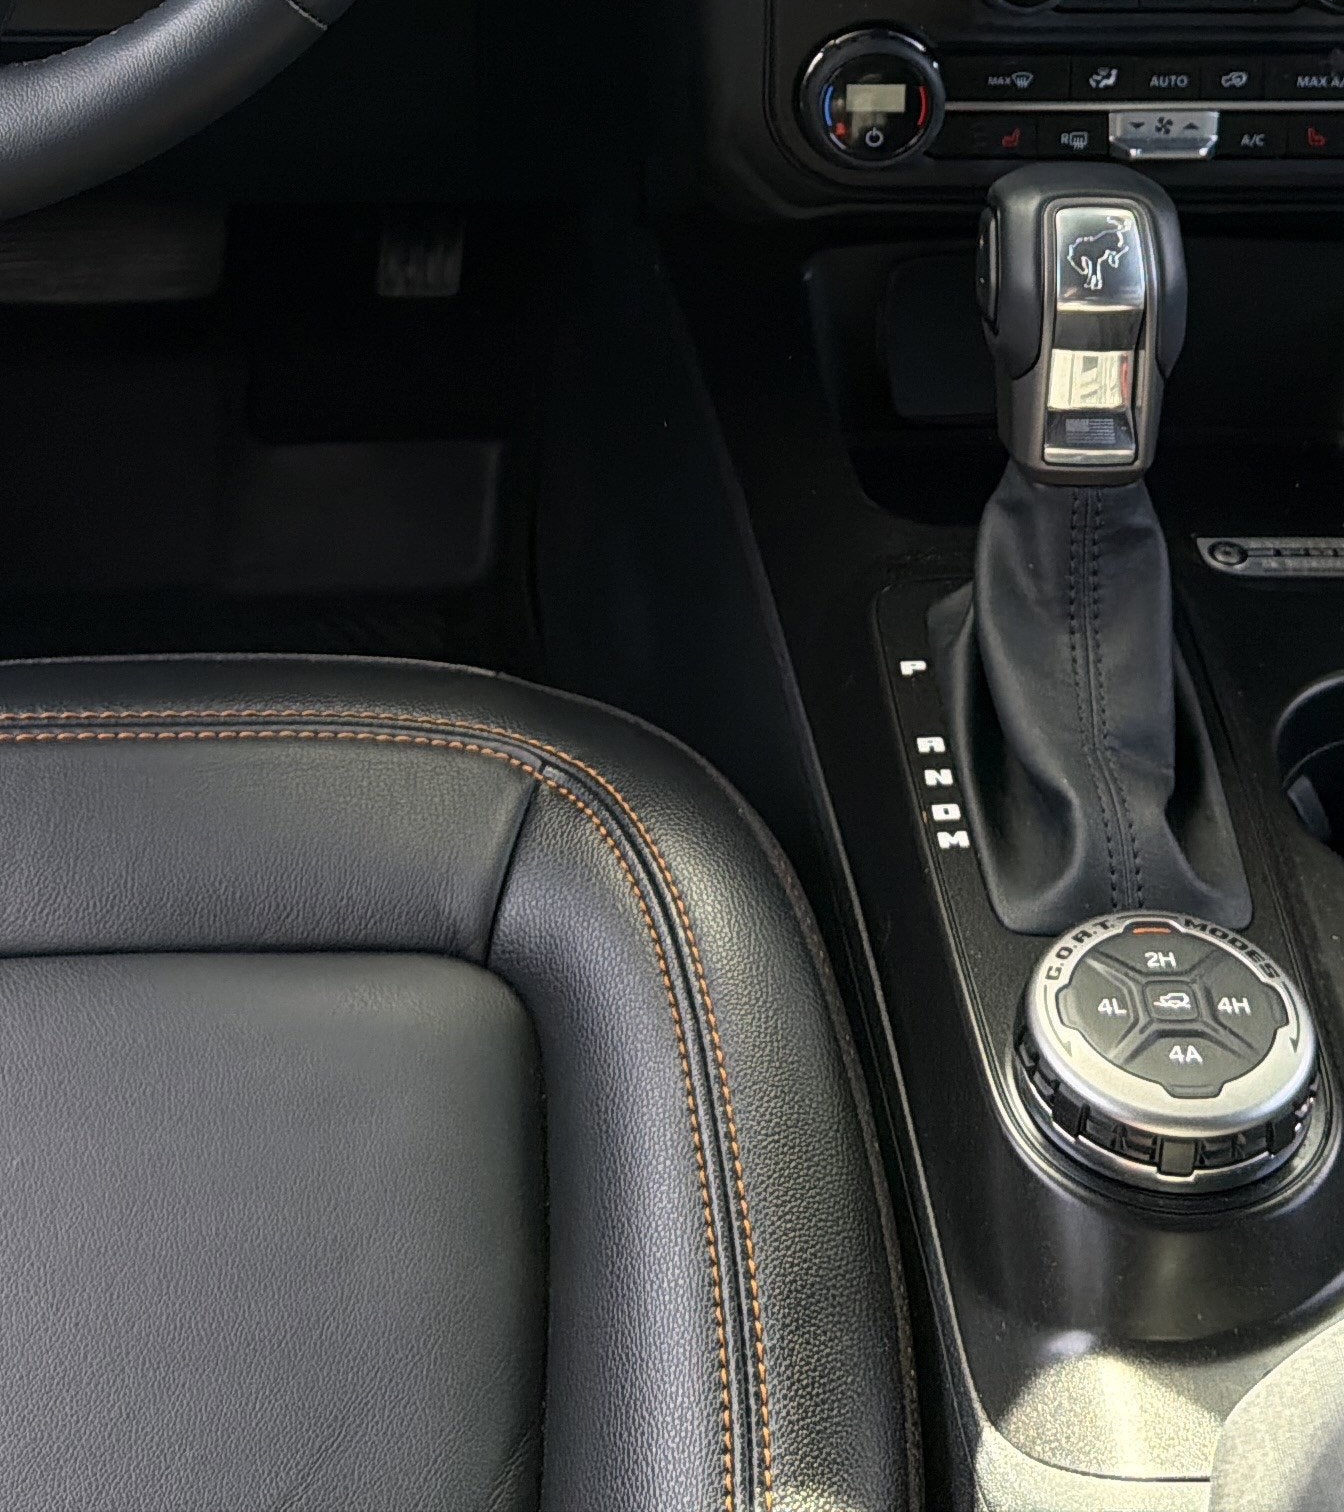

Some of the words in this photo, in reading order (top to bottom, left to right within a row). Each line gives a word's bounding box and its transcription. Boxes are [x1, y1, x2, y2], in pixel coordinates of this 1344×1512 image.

[987, 75, 1011, 86] MAX
[1150, 74, 1188, 88] AUTO
[1297, 74, 1327, 88] MAX
[1241, 133, 1265, 147] A/C
[899, 660, 927, 676] P
[924, 768, 954, 786] N
[936, 830, 970, 849] M
[1183, 918, 1279, 981] MODES
[1144, 951, 1177, 968] 2H
[1097, 997, 1127, 1015] 4L
[1217, 997, 1251, 1015] 4H
[1168, 1044, 1204, 1064] 4A
